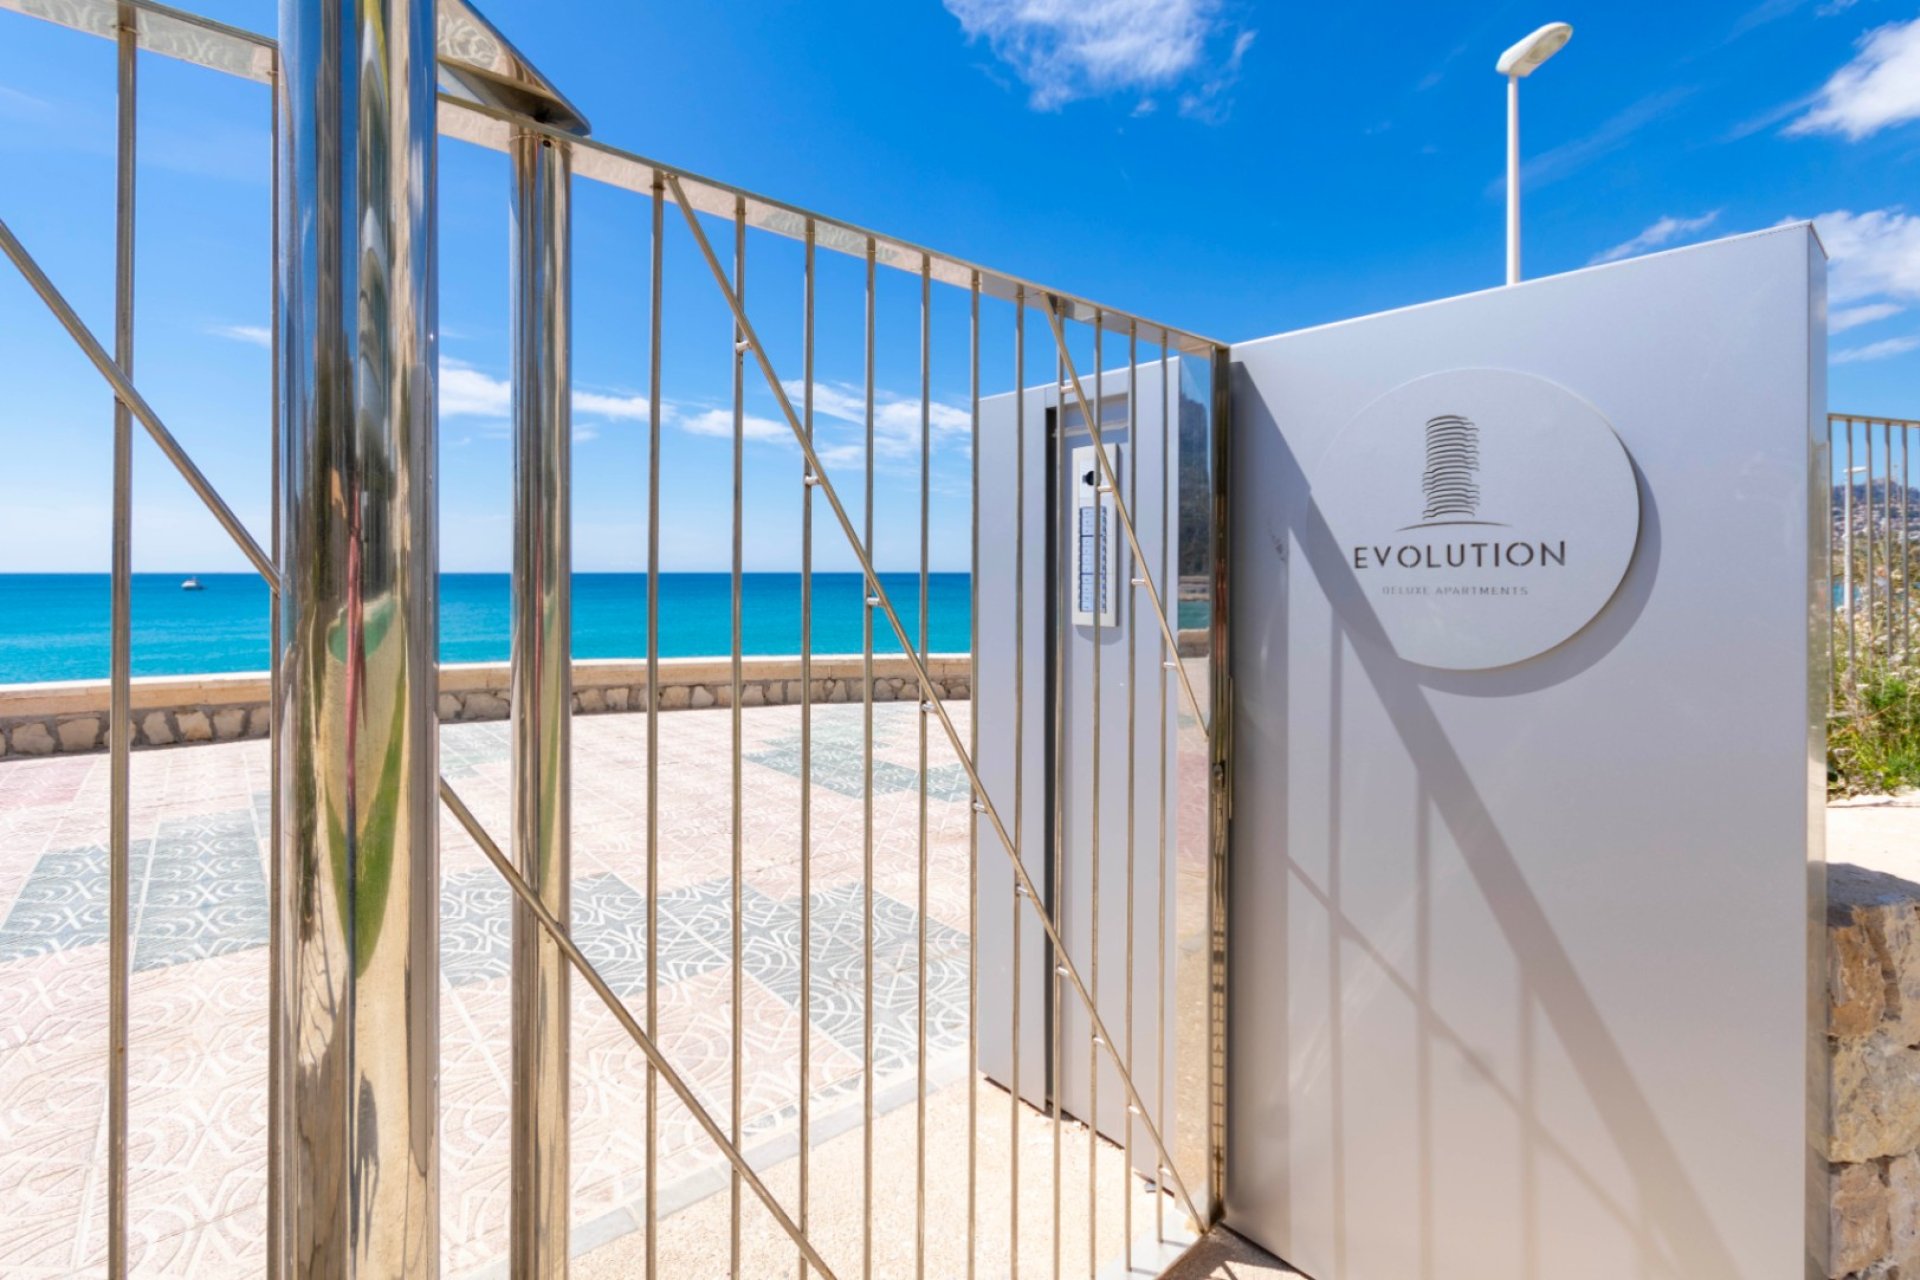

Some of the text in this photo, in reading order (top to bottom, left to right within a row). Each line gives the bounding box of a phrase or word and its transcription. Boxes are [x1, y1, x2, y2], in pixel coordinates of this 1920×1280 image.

[1354, 541, 1566, 569] EVOLUTION
[1381, 585, 1529, 596] DELUXE APARTMENTS
